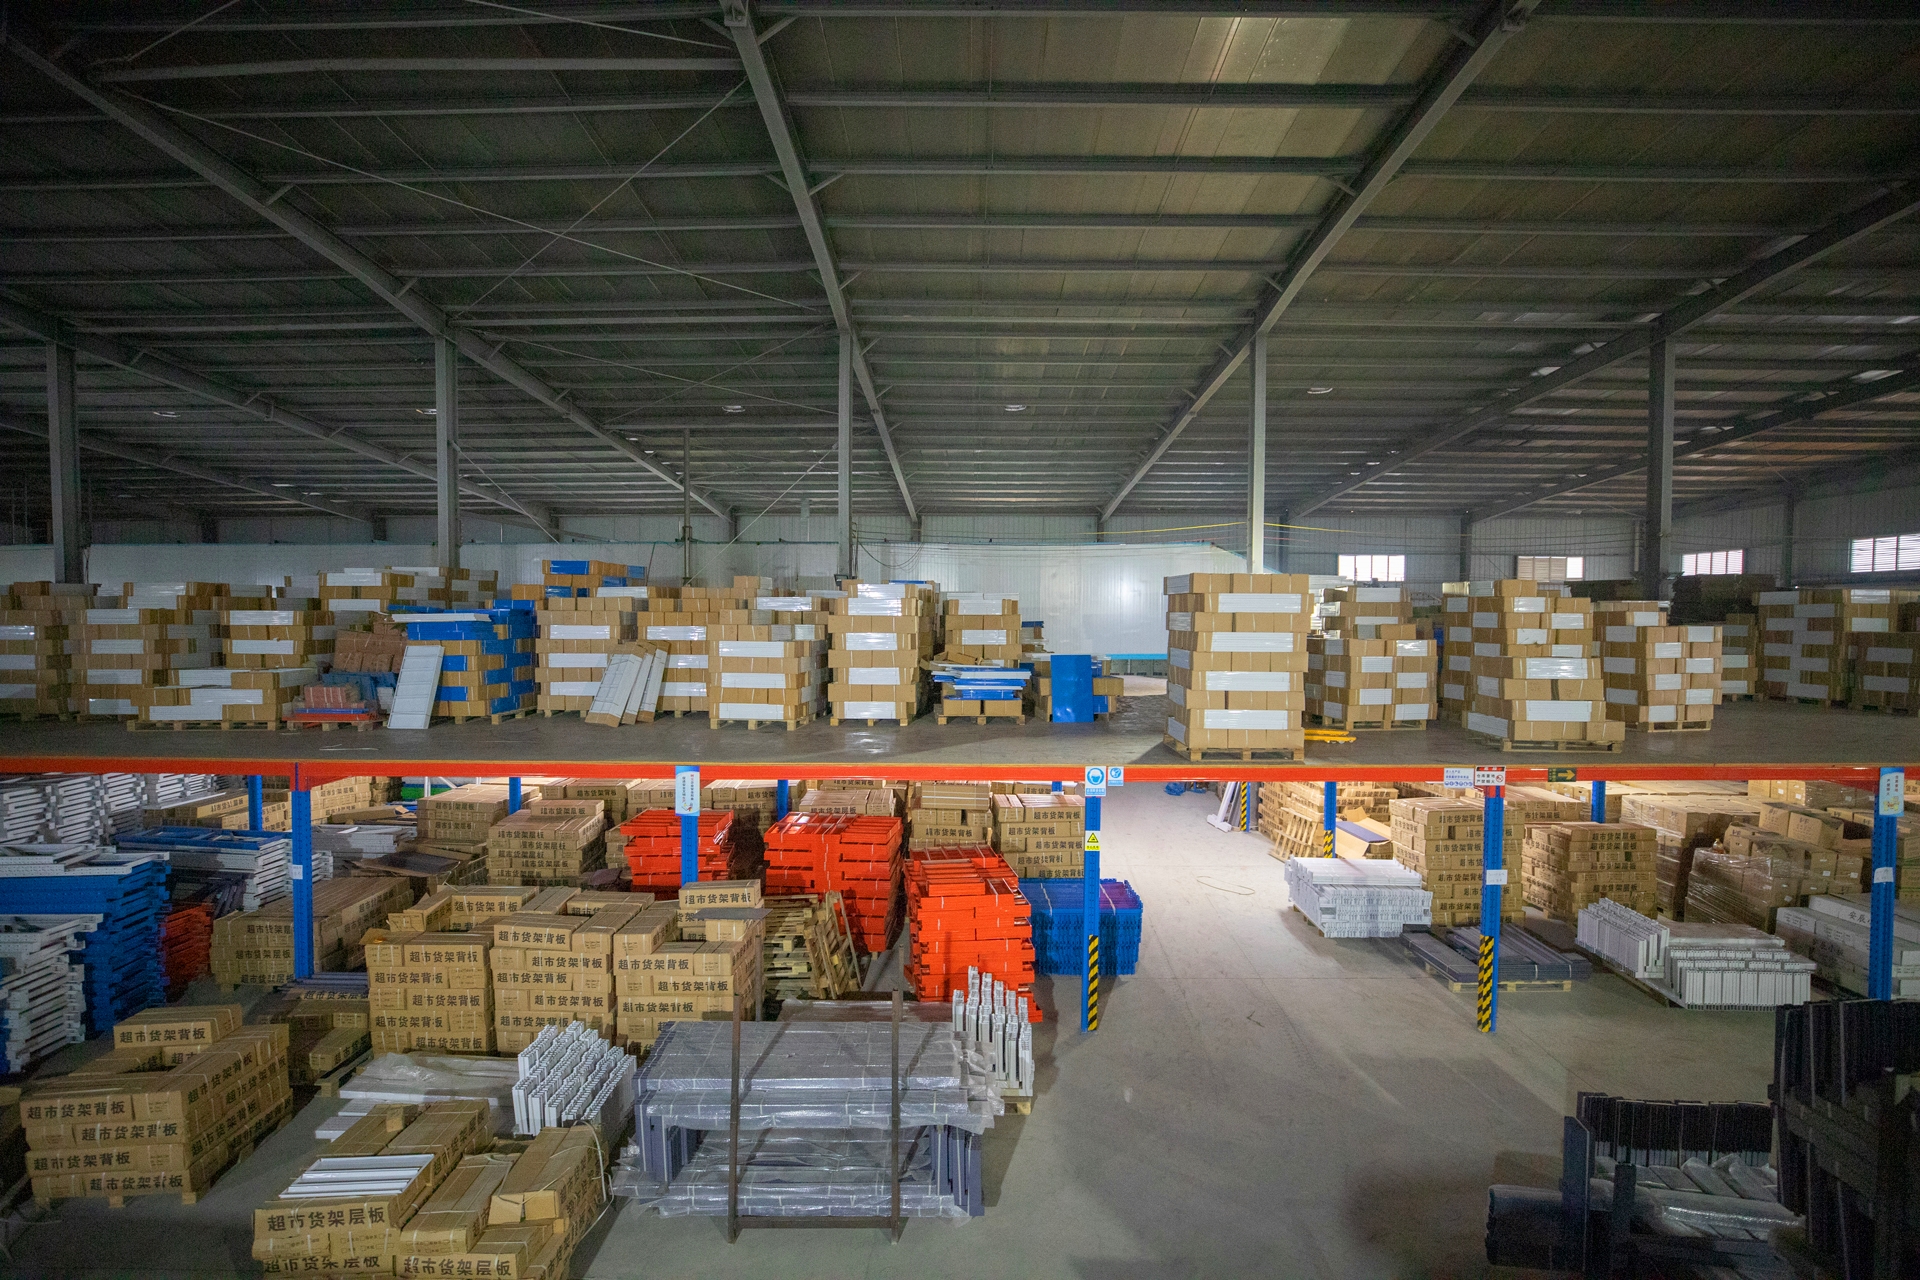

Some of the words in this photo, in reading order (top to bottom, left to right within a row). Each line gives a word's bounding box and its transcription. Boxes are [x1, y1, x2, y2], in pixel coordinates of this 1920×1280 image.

[1034, 811, 1081, 820] 超市货架背板
[1008, 826, 1056, 836] 超市货架背板
[1035, 840, 1083, 850] 超市货架背板
[685, 892, 752, 905] 超市货架背板
[454, 901, 518, 912] 超市货架背板
[498, 931, 567, 945] 超市货架背板
[409, 951, 479, 963] 超市货架背板
[532, 956, 603, 970] 超市货架背板
[618, 958, 690, 970] 超市货架背板
[375, 972, 443, 984] 超市货架背板
[497, 972, 567, 984] 超市货架背板
[658, 981, 729, 992] 超市货架背板
[412, 994, 481, 1007] 超市货架背板
[534, 994, 605, 1008] 超市货架背板
[622, 1002, 694, 1014] 超市货架背板
[375, 1015, 443, 1028] 超市货架背板
[500, 1015, 570, 1029] 超市货架背板
[119, 1027, 206, 1043] 超市货架背板
[416, 1036, 483, 1050] 超市货架背板
[27, 1101, 126, 1120] 超市货架背板
[82, 1122, 179, 1142] 超市货架背板
[33, 1151, 132, 1172] 超市货架背板
[90, 1174, 184, 1192] 超市货架背板
[267, 1206, 386, 1232] 超市货架层板
[403, 1256, 512, 1277] 超市货架层板
